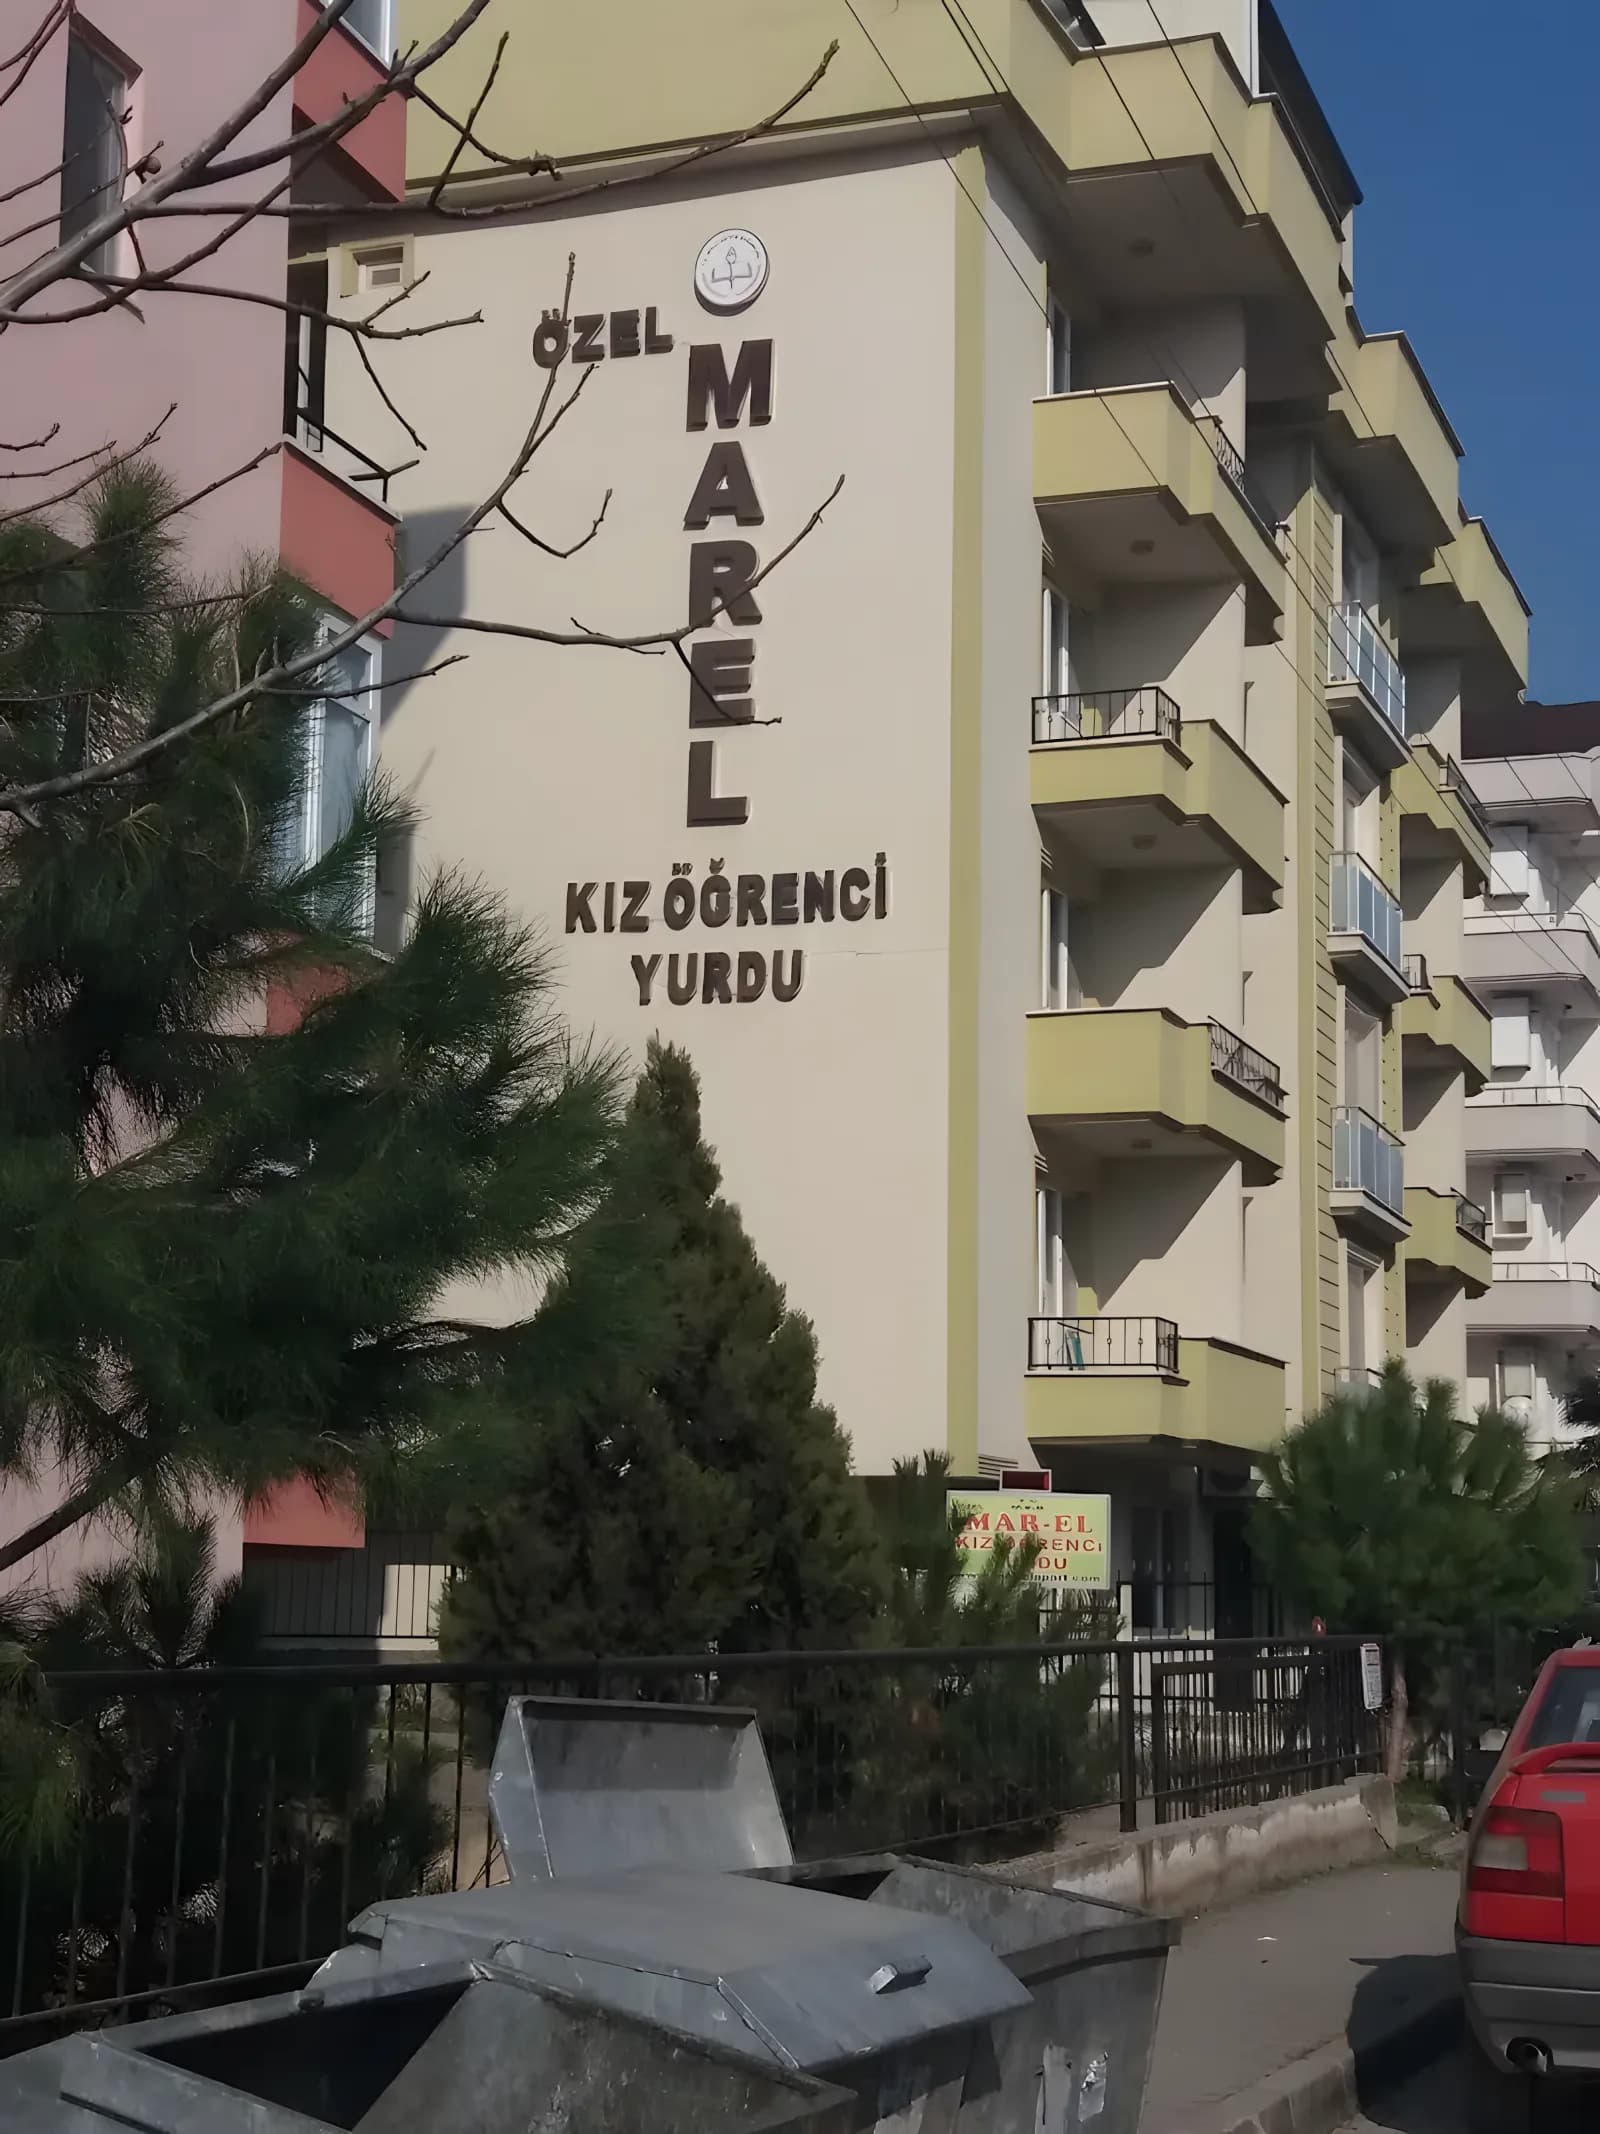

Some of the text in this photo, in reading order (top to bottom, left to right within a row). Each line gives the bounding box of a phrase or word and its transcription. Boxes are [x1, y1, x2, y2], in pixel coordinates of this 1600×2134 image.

[533, 307, 674, 368] ÖZEL
[683, 338, 774, 828] MAREL
[565, 852, 888, 934] KIZ ÖĞRENCİ
[631, 949, 803, 1006] YURDU
[955, 1536, 993, 1549] KIZ
[966, 1512, 1093, 1533] MAR-EL
